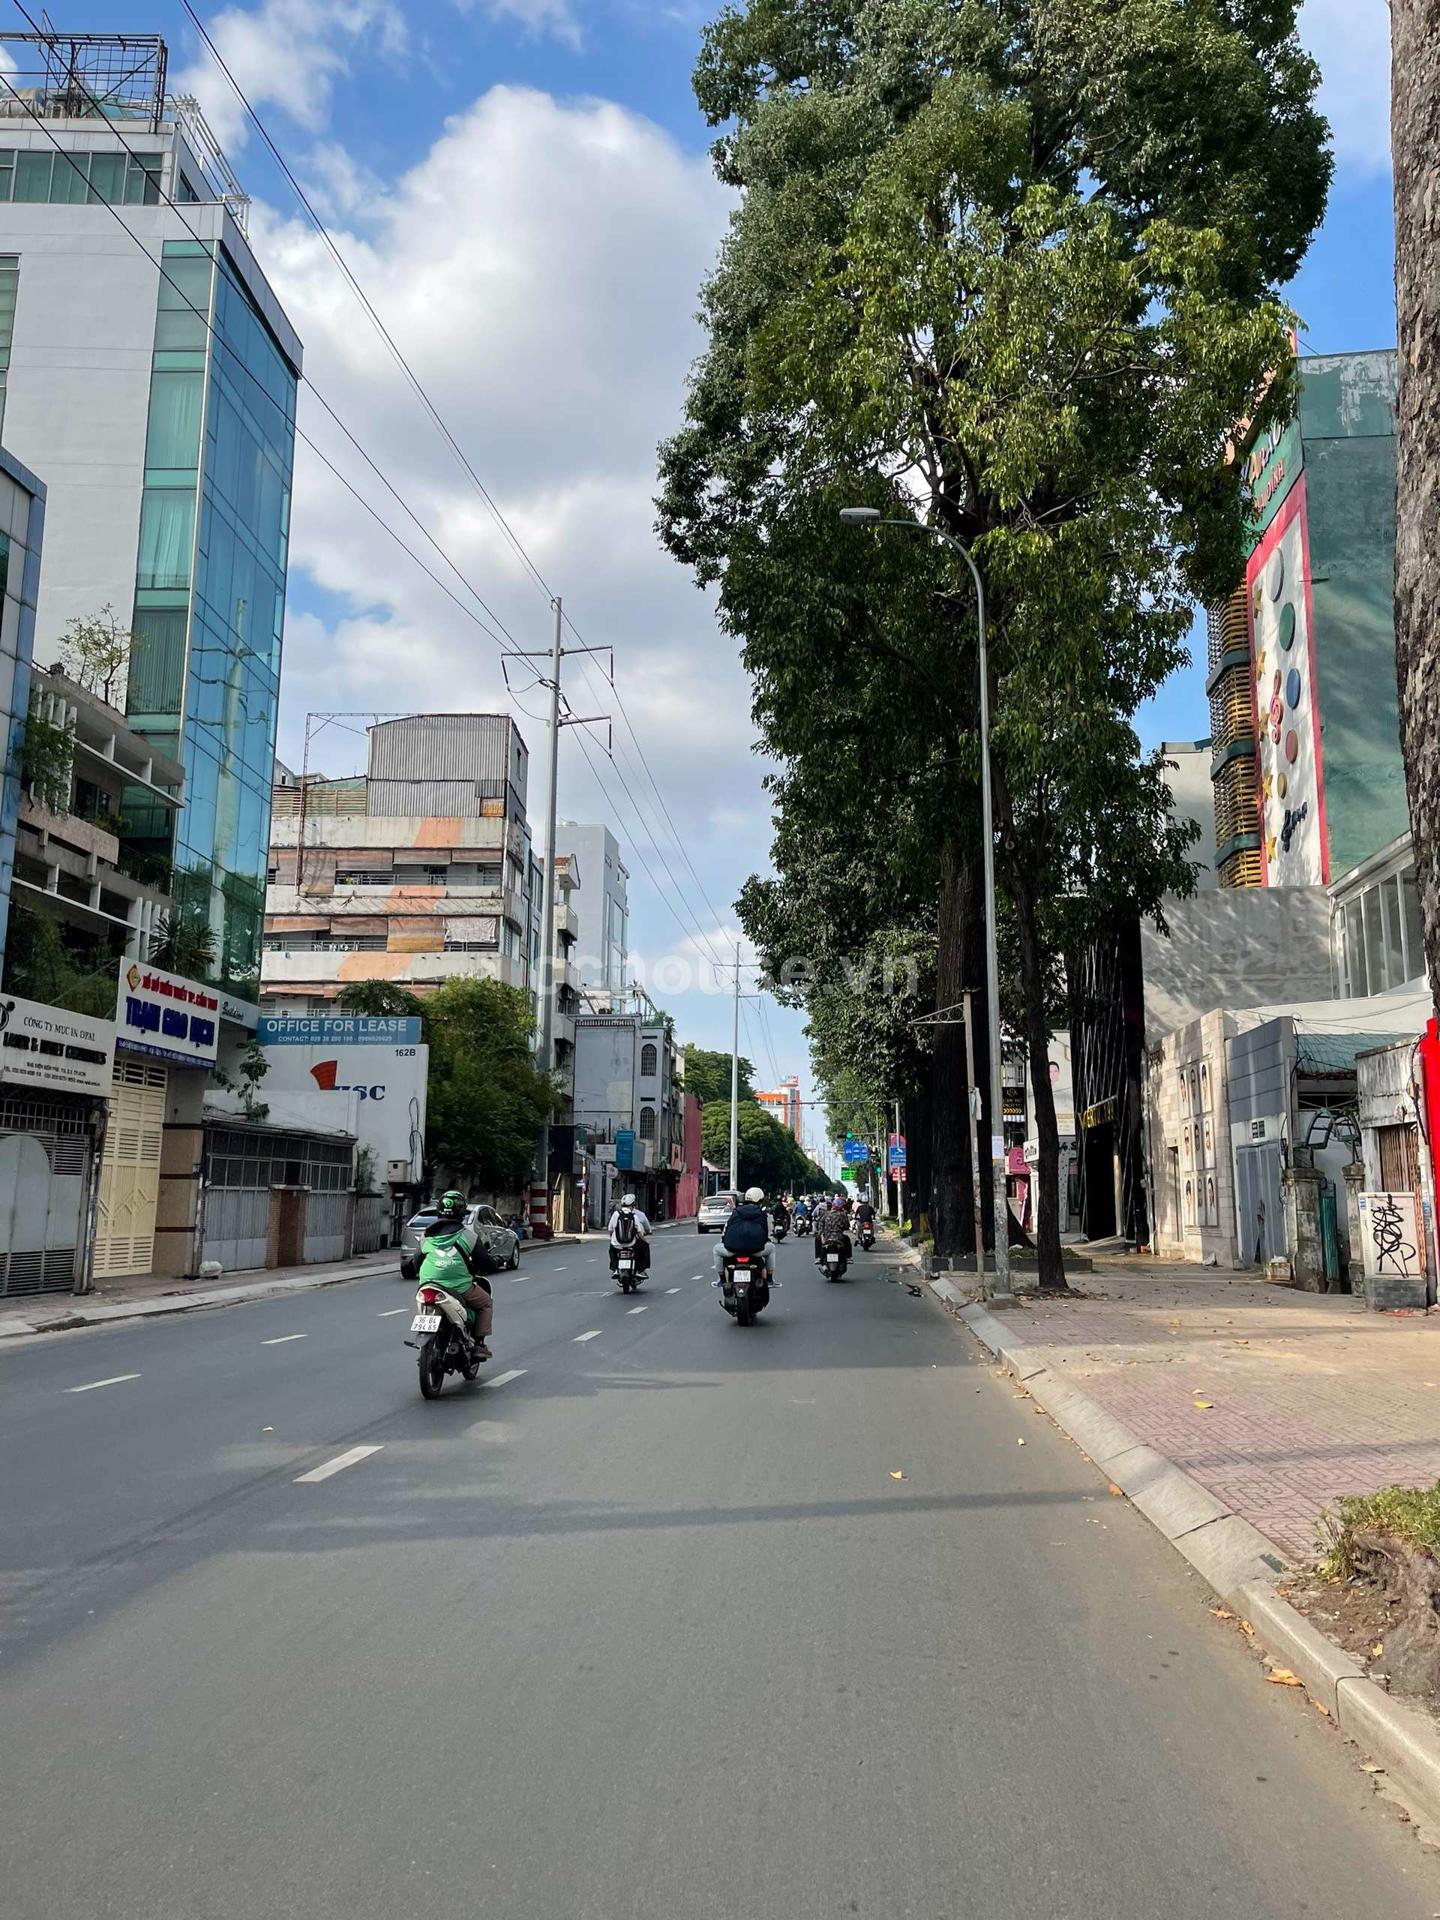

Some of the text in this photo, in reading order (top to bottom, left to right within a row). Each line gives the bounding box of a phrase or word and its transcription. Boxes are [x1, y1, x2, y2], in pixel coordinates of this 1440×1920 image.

[267, 1020, 407, 1032] OFFICE FOR LEASE
[395, 1048, 416, 1057] 162B
[334, 1084, 385, 1100] SC
